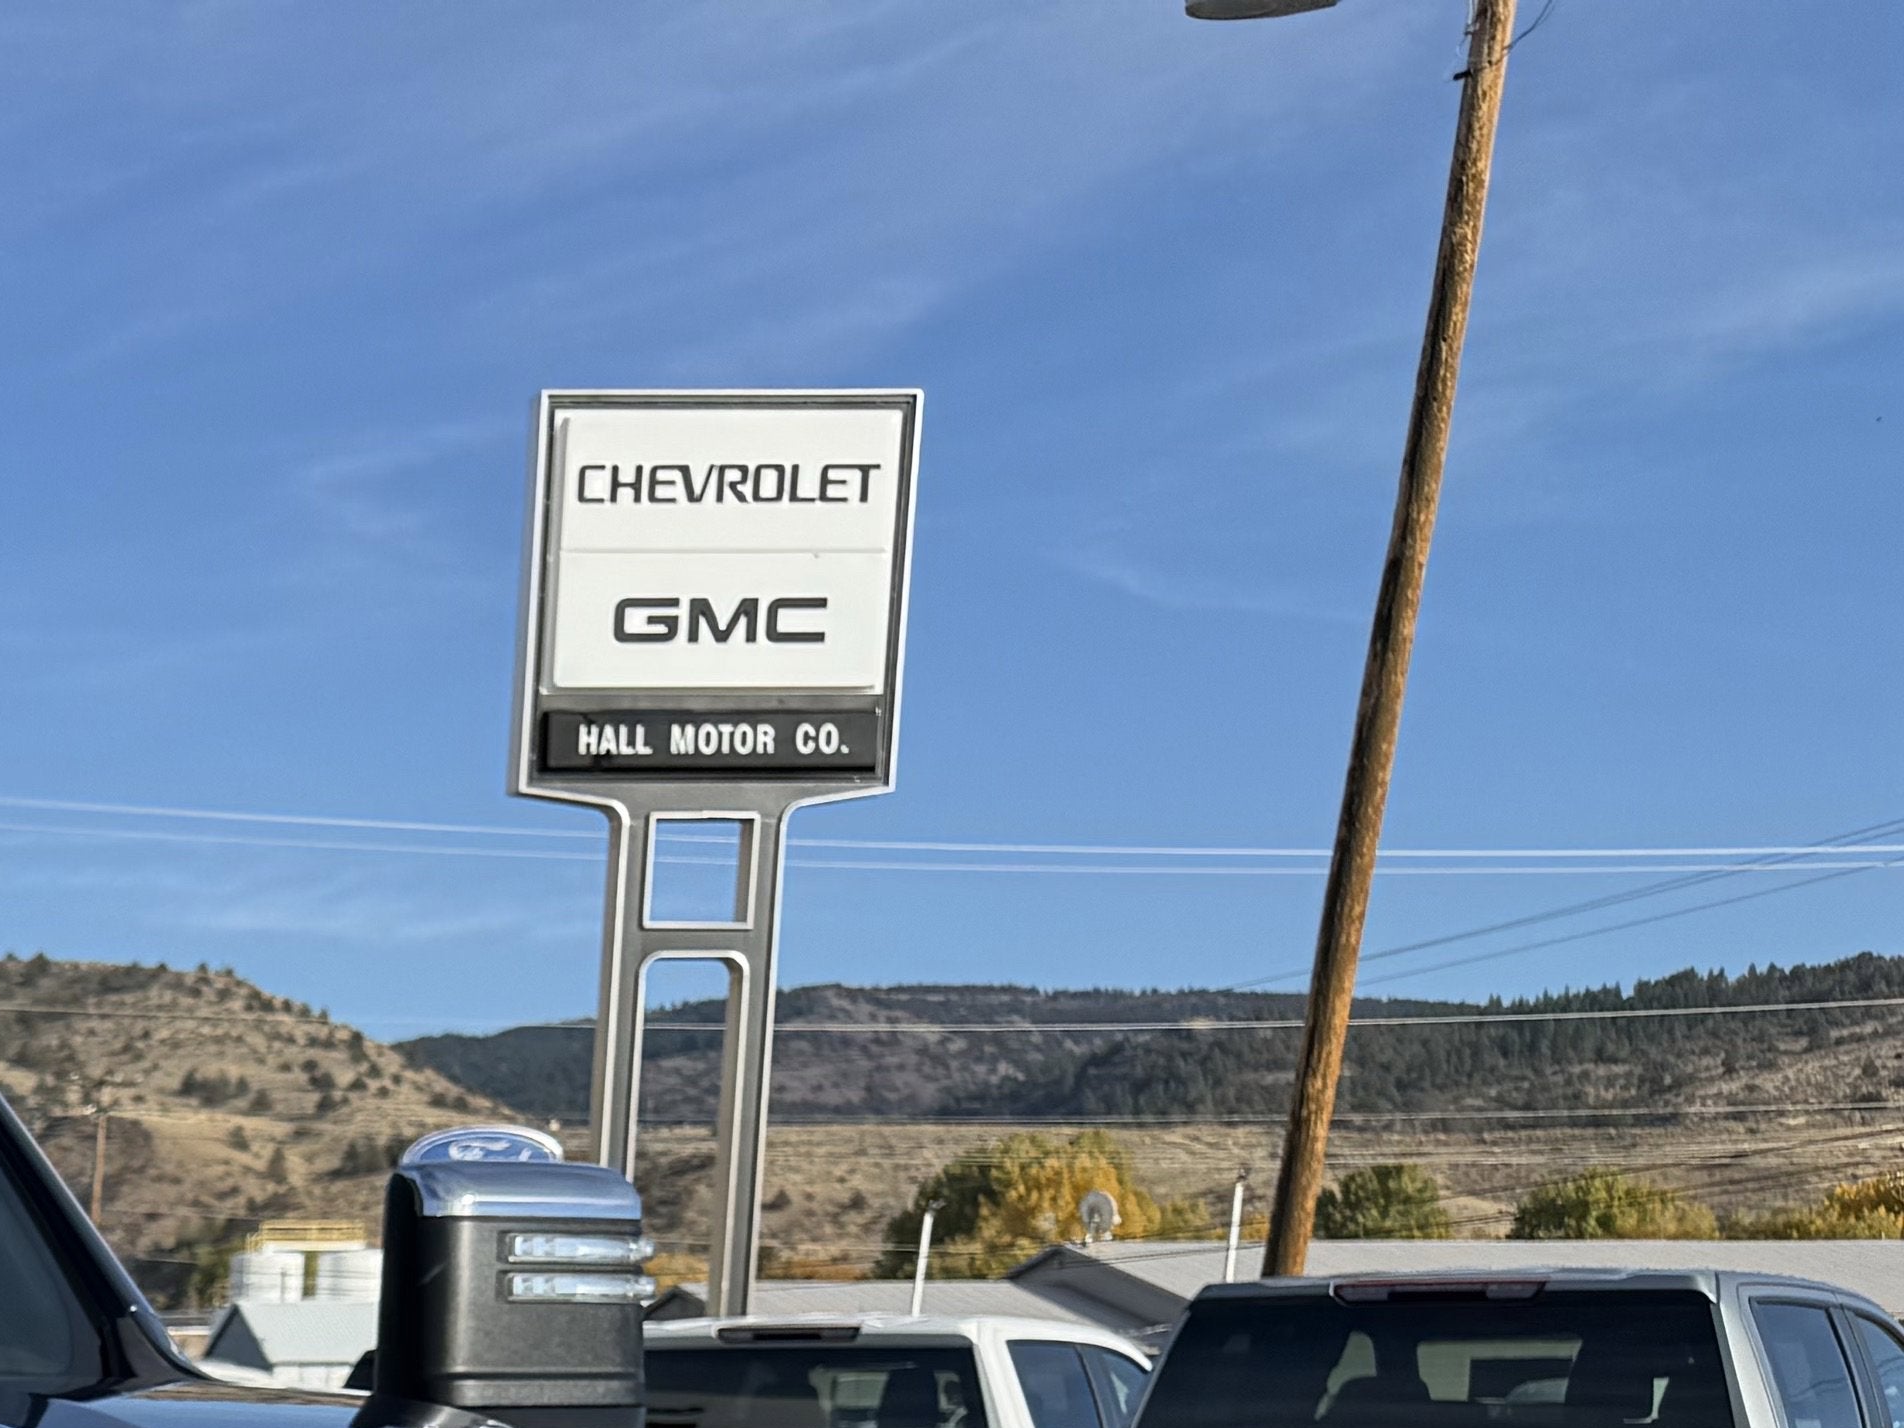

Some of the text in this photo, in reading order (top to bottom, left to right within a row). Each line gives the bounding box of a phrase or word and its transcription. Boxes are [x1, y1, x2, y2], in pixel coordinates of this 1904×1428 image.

[577, 463, 881, 504] CHEVROLET
[613, 597, 828, 644] GMC
[578, 722, 850, 755] HALL MOTOR CO.
